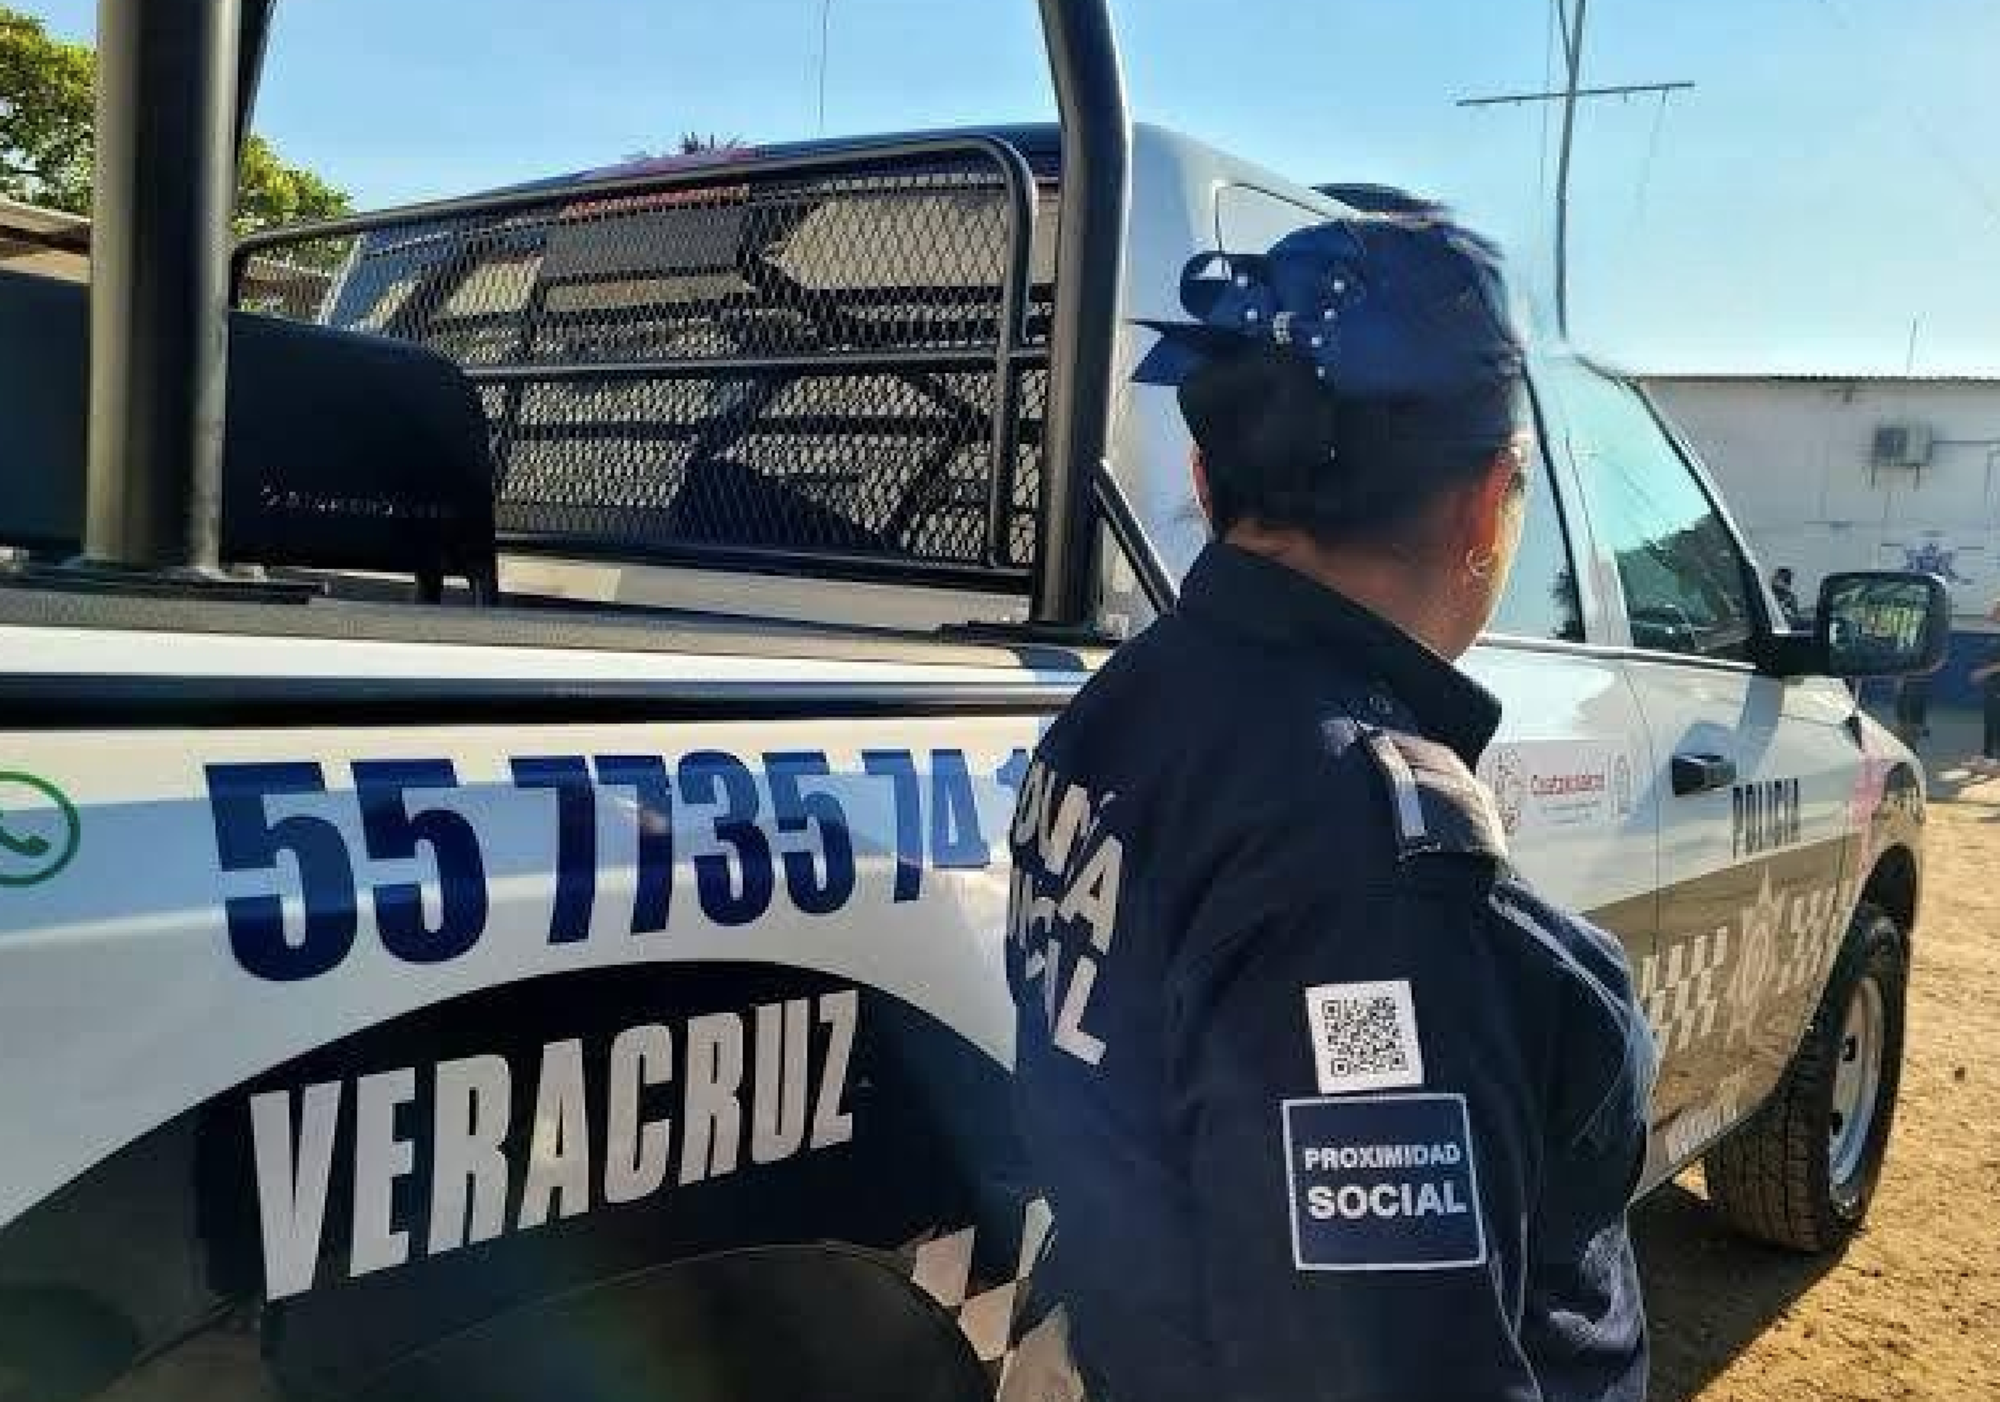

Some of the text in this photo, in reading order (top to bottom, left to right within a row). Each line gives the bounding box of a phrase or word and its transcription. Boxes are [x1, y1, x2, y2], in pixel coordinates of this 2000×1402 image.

[204, 758, 489, 981] 55
[509, 749, 855, 945] 7735
[250, 989, 859, 1301] VERACRUZ
[1305, 1143, 1461, 1171] PROXIMIDAD
[1308, 1181, 1467, 1219] SOCIAL
